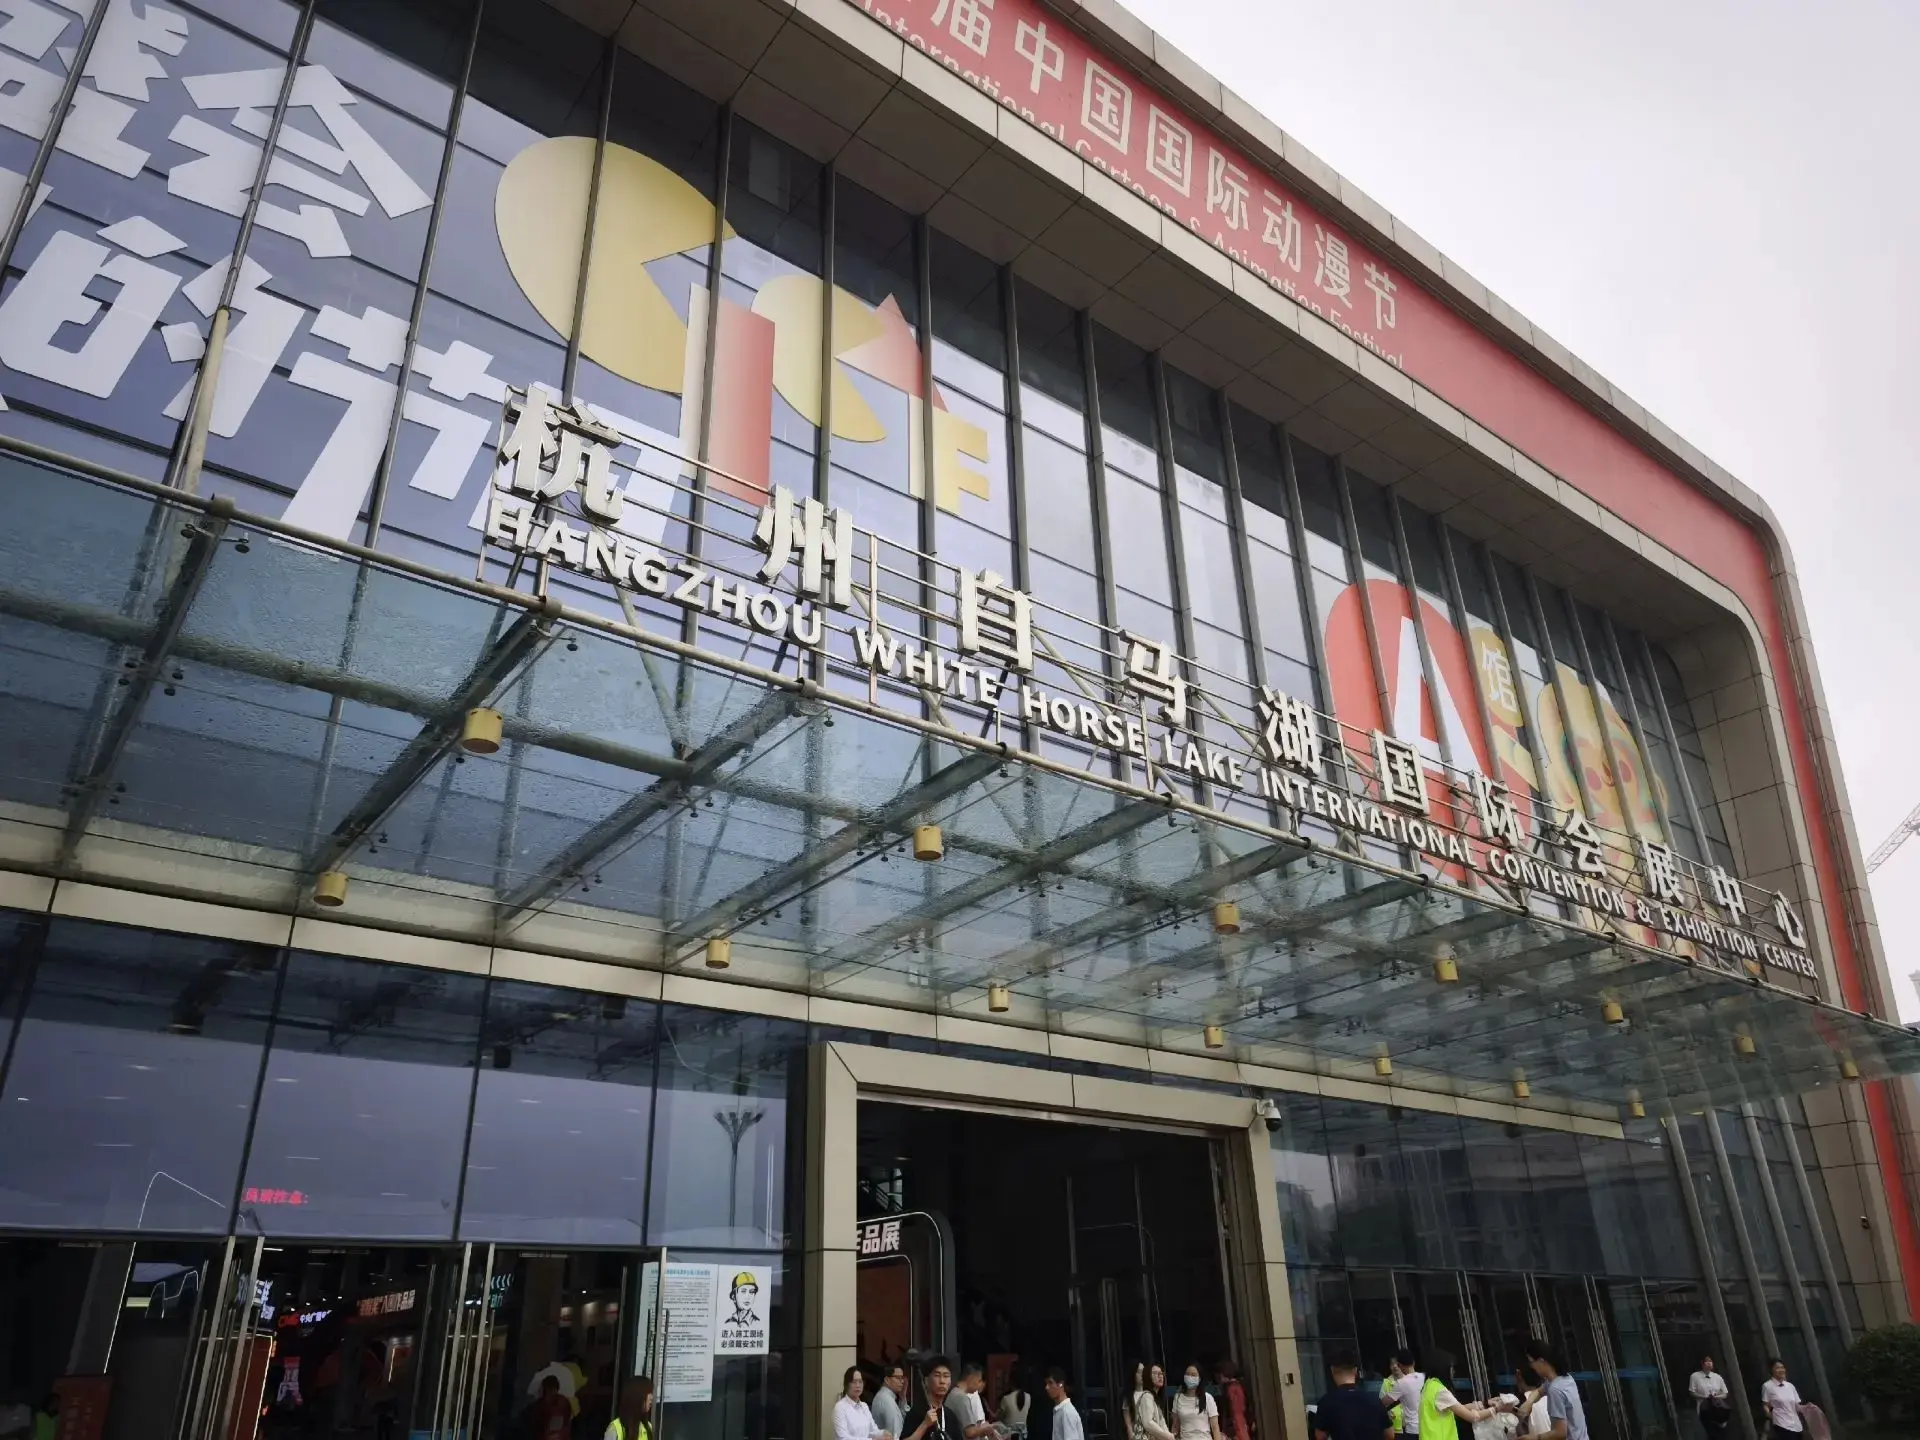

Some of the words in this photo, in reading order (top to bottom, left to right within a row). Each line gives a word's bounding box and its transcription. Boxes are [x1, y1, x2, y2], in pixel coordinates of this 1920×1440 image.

[485, 499, 822, 647] HANGZHOU
[852, 628, 1000, 709] WHITE
[1021, 685, 1146, 757] HORSE
[1160, 733, 1244, 790] LAKE
[1257, 767, 1477, 868] INTERNATIONAL
[1486, 849, 1628, 918] CONVENTION
[1634, 899, 1654, 927] &
[1658, 905, 1760, 961] EXHIBITION
[1762, 943, 1819, 980] CENTER
[500, 383, 1807, 948] 杭州白马湖国际会展中心
[856, 1220, 903, 1254] 品展
